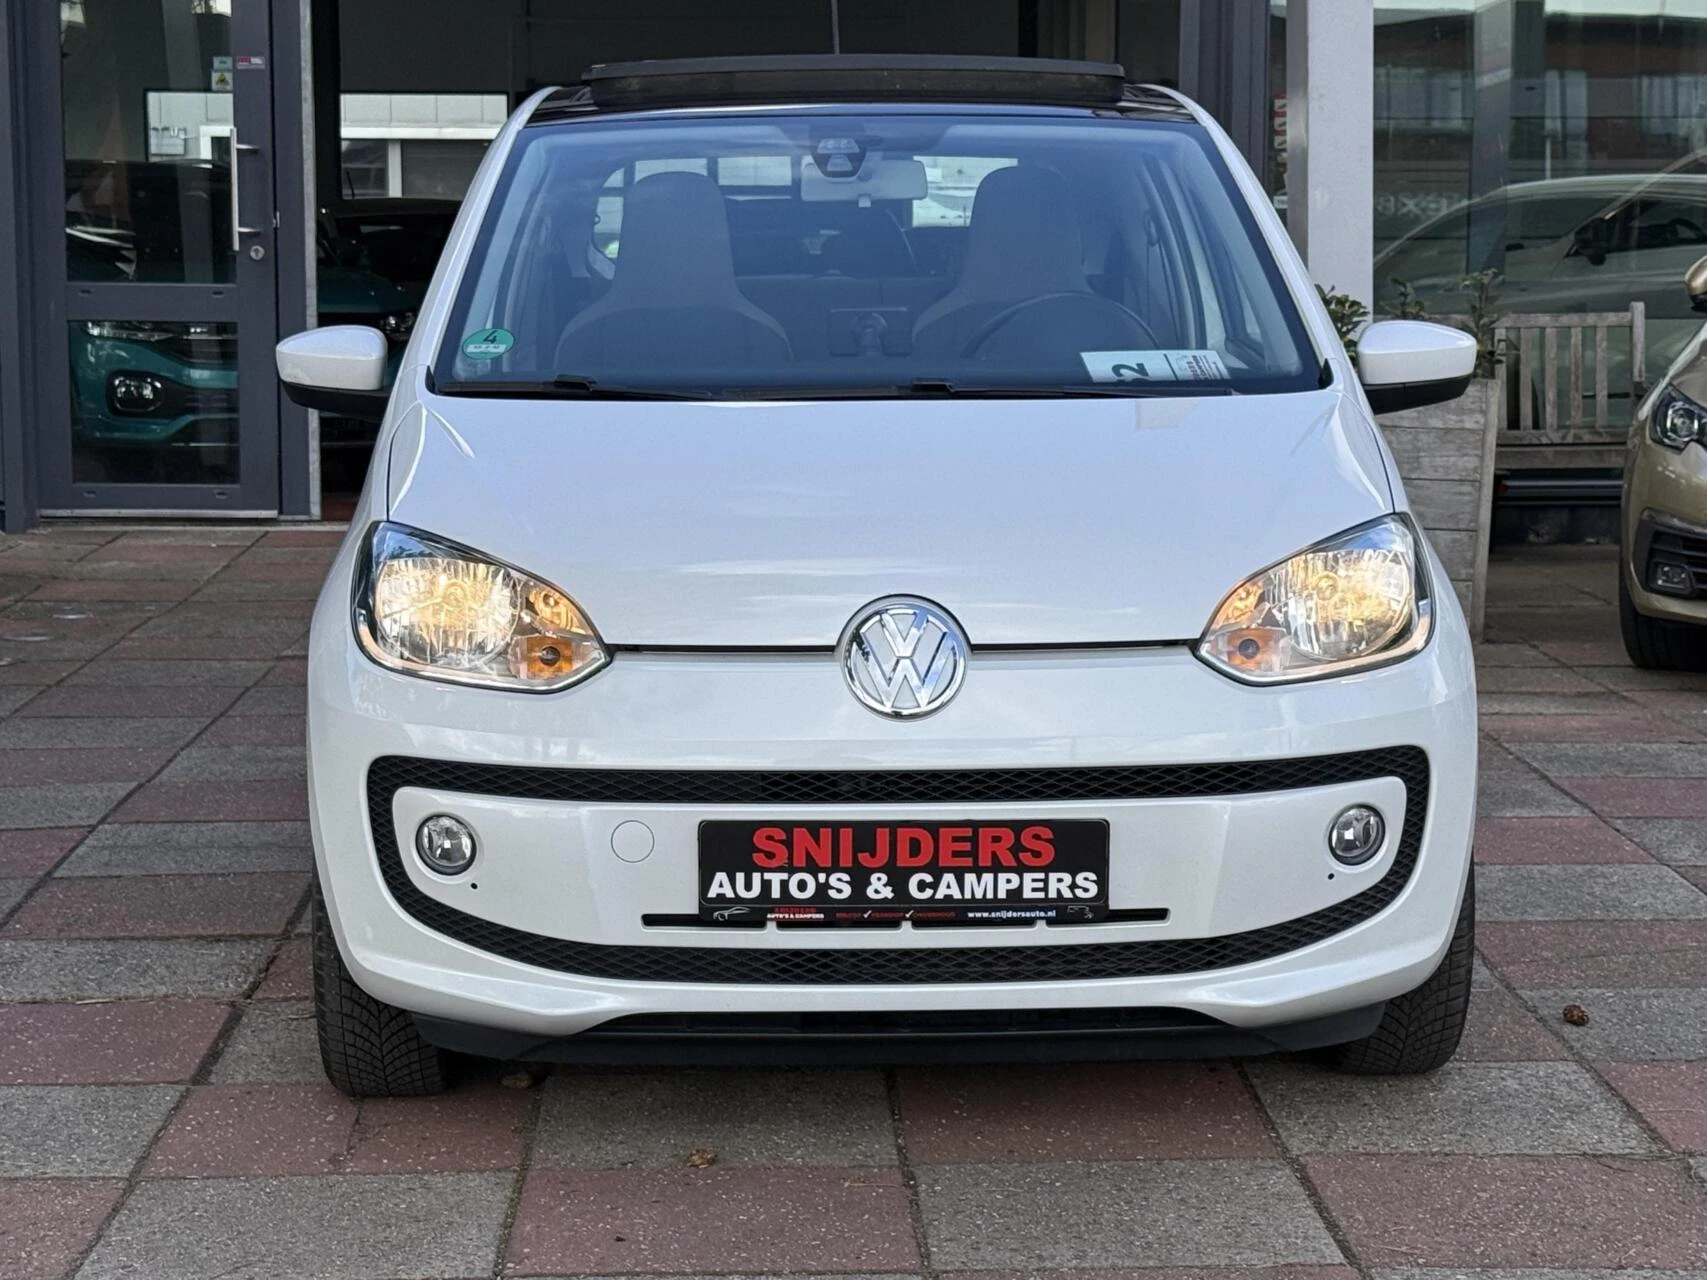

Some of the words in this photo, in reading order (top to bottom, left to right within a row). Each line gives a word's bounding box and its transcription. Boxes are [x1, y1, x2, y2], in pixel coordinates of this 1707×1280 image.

[483, 330, 498, 345] 4
[752, 826, 1056, 868] SNIJDERS
[707, 872, 852, 899] AUTO'S
[866, 873, 895, 899] &
[908, 872, 1098, 899] CAMPERS
[968, 910, 1056, 919] www.snijdersauto.nl
